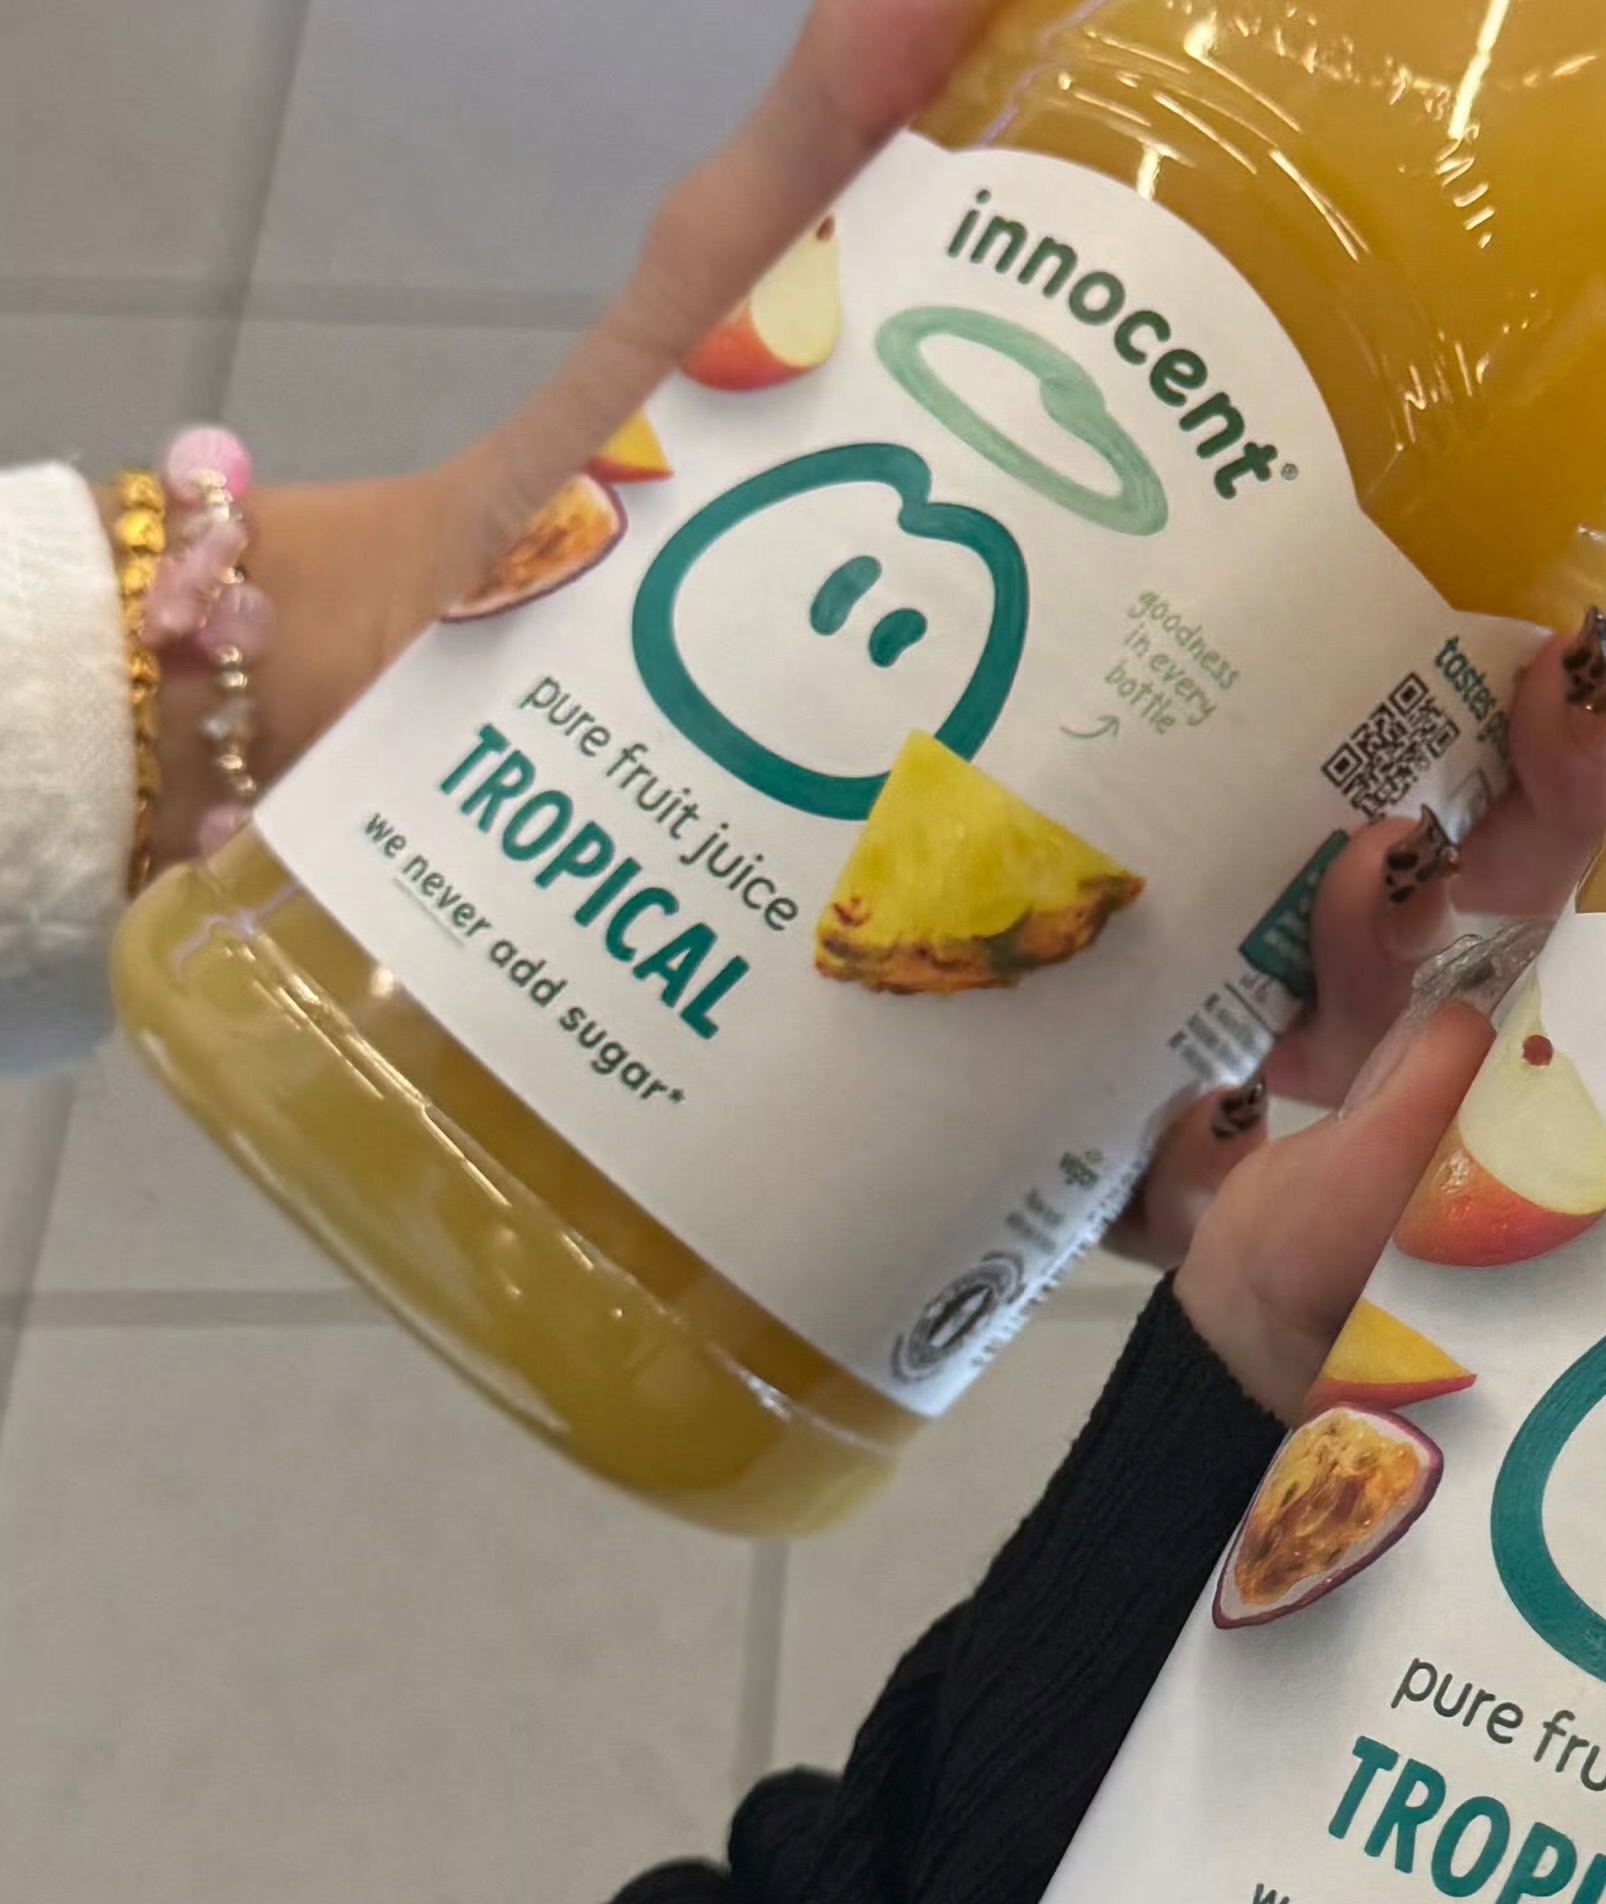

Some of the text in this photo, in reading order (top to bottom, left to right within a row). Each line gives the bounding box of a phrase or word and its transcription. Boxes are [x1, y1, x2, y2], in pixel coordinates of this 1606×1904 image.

[1123, 627, 1219, 725] in every
[1130, 590, 1240, 690] goodness
[1103, 662, 1180, 735] bottle
[519, 676, 800, 932] pure fruit juice
[365, 813, 407, 858] we
[402, 854, 492, 937] never
[489, 940, 566, 1007] add
[439, 724, 749, 1039] TROPICAL
[1390, 1657, 1524, 1745] pure
